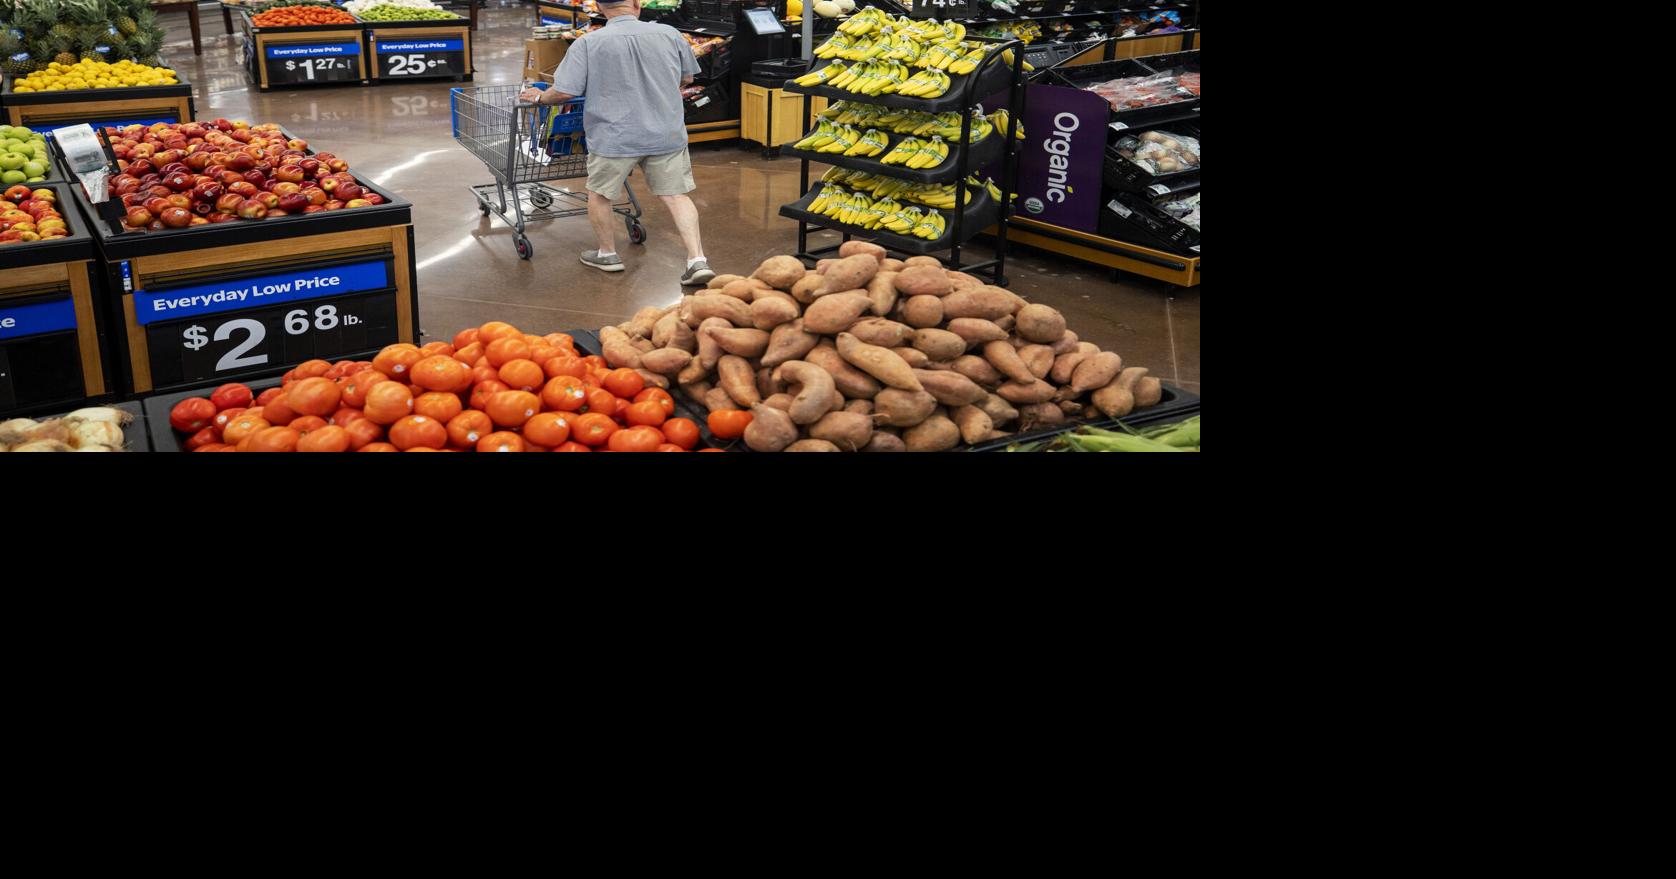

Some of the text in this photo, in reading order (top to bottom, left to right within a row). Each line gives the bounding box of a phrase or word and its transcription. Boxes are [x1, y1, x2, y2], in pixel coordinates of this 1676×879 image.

[1043, 112, 1080, 204] Organic
[152, 274, 341, 312] Everyday Low Price
[284, 304, 339, 336] 68
[343, 315, 363, 327] lb.
